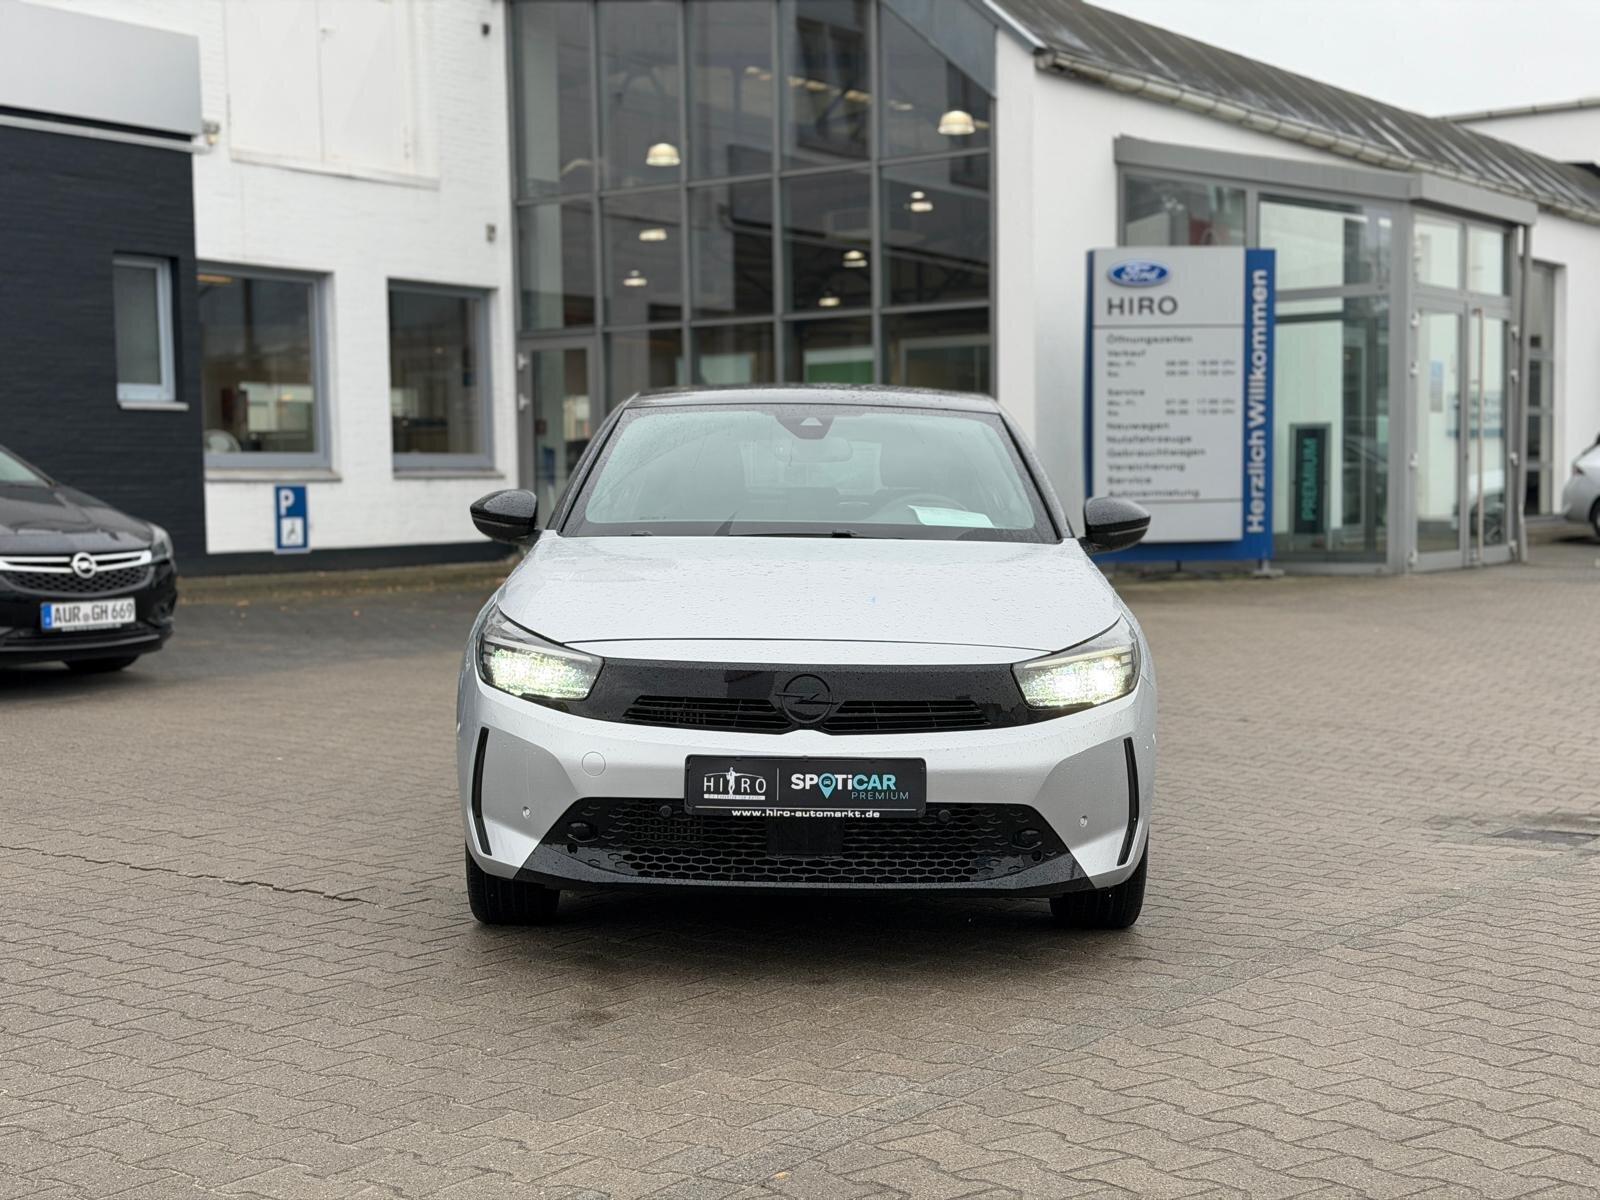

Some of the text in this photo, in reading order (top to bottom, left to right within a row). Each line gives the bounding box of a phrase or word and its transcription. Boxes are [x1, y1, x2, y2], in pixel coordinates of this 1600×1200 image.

[1107, 296, 1178, 315] HIRO
[1246, 269, 1268, 533] Herzlich Willkommen
[278, 489, 294, 516] P
[54, 602, 134, 624] AUR GH 669
[703, 776, 767, 794] HIRO
[731, 808, 880, 819] www.hiro-automarkt.de
